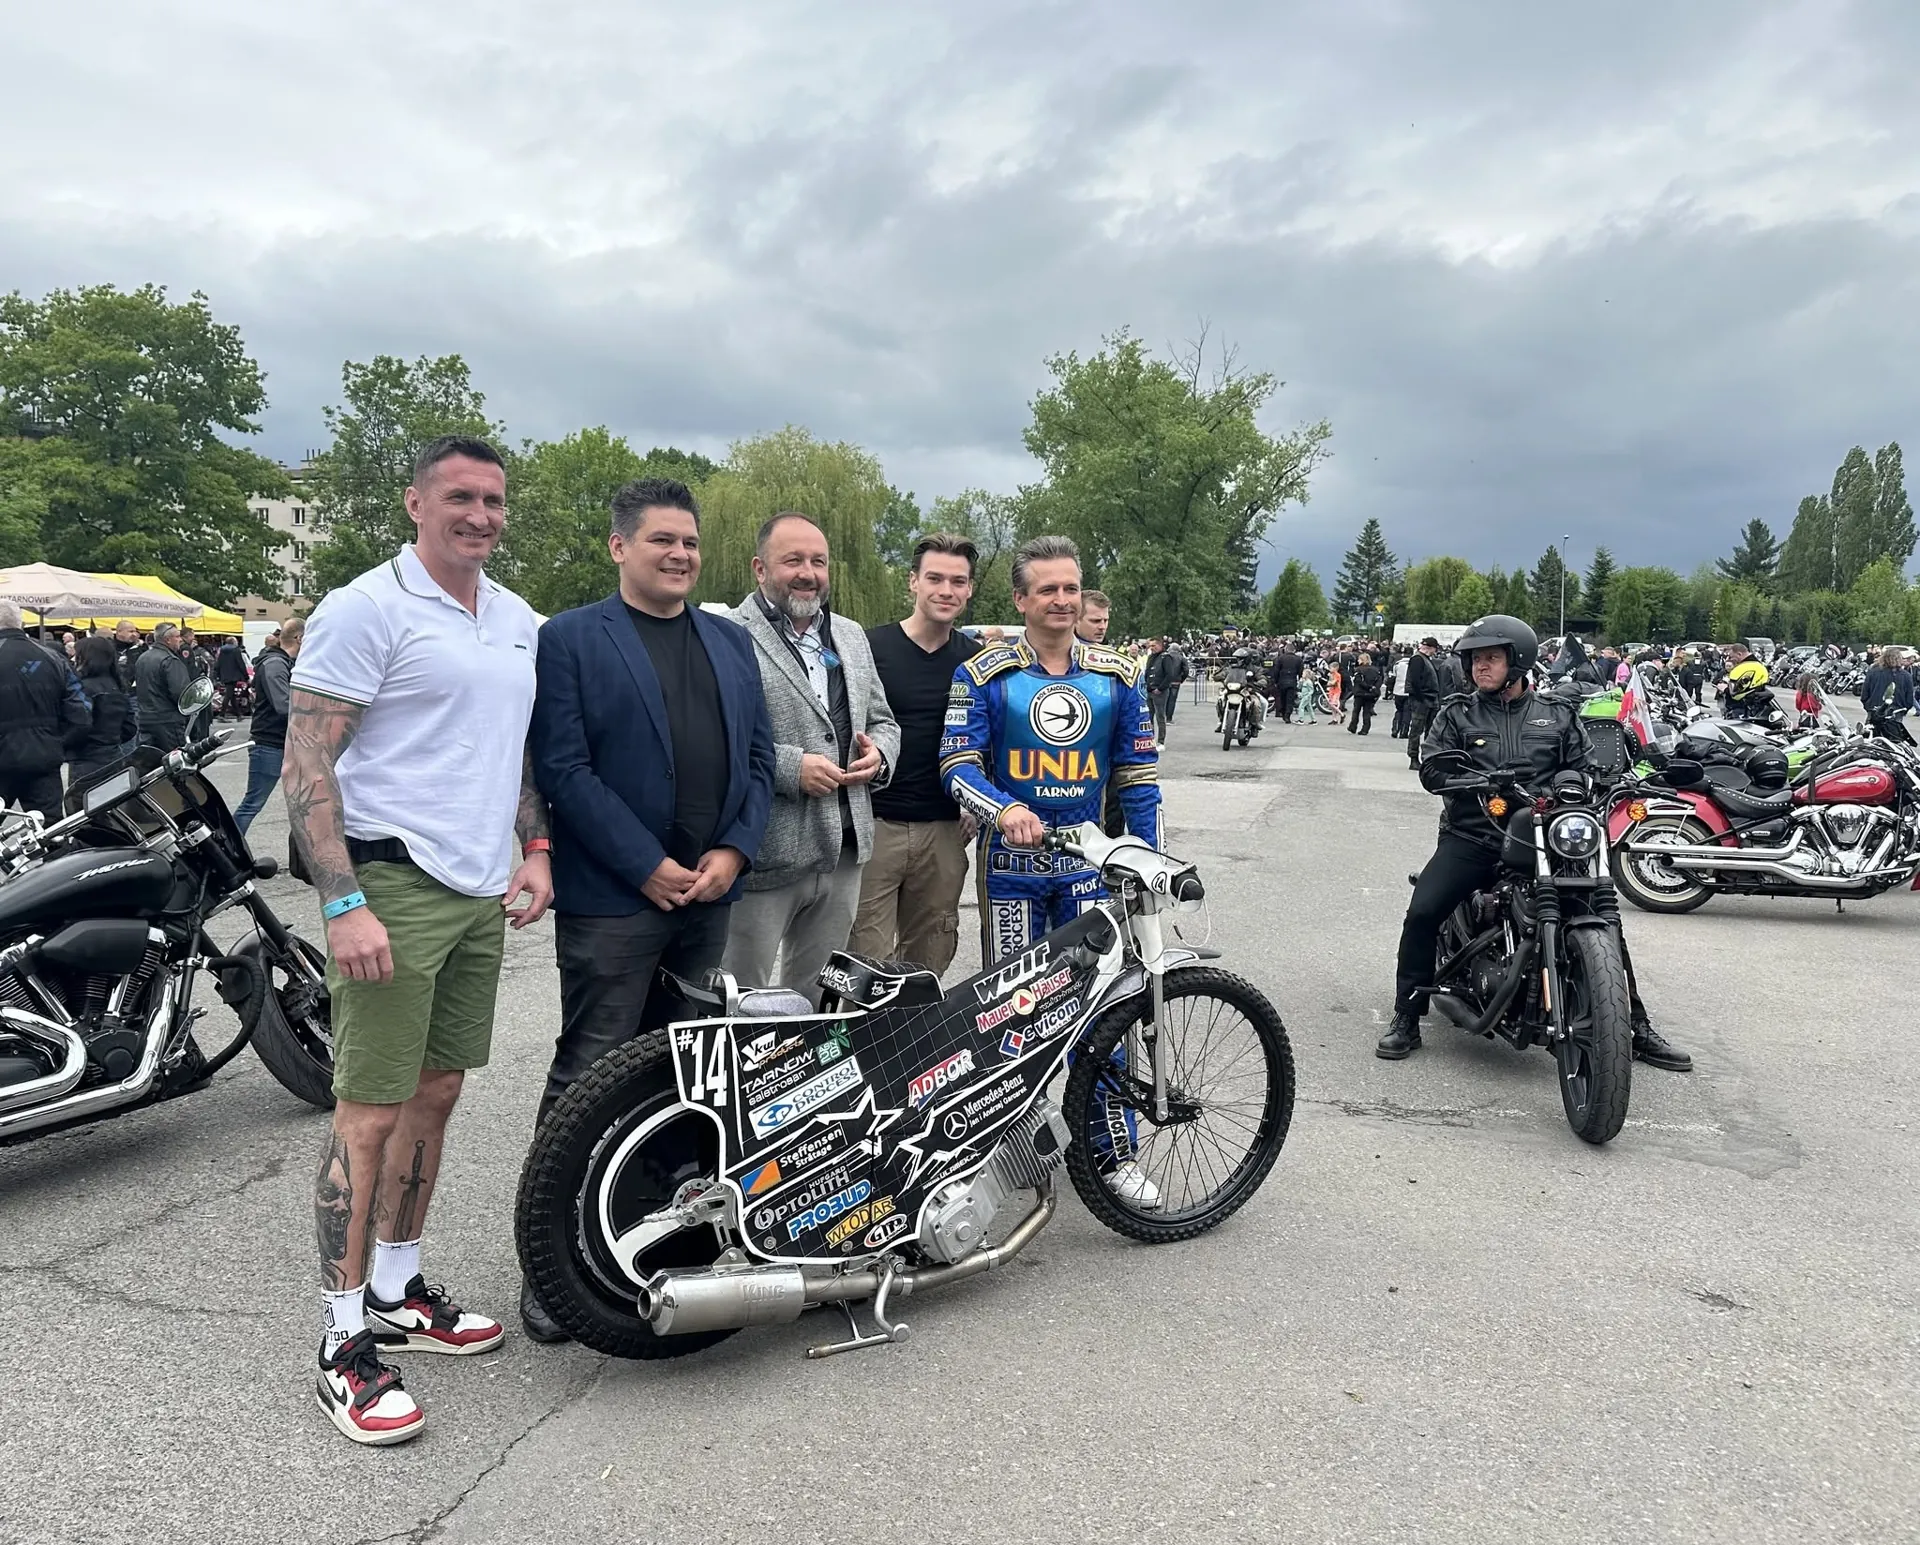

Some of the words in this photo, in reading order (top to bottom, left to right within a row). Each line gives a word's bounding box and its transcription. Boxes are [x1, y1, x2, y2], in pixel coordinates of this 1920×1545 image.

[80, 597, 108, 606] CENTRUM
[1009, 749, 1099, 781] UNIA
[1034, 785, 1086, 798] TARNÓW
[1072, 877, 1101, 897] Piot
[1154, 876, 1164, 891] 14
[992, 901, 1012, 959] ONTROL
[1010, 900, 1024, 953] ROCESS
[976, 1002, 1014, 1033] Mauer
[1030, 967, 1071, 1001] Häuser
[677, 1026, 727, 1107] #14
[908, 1049, 976, 1109] ADBOR
[963, 1074, 1024, 1118] Mercedes-Benz
[780, 1129, 842, 1167] Steffensen
[787, 1179, 870, 1241] PROBUD
[829, 1200, 894, 1244] WŁODAR
[376, 1371, 393, 1387] NIKE
